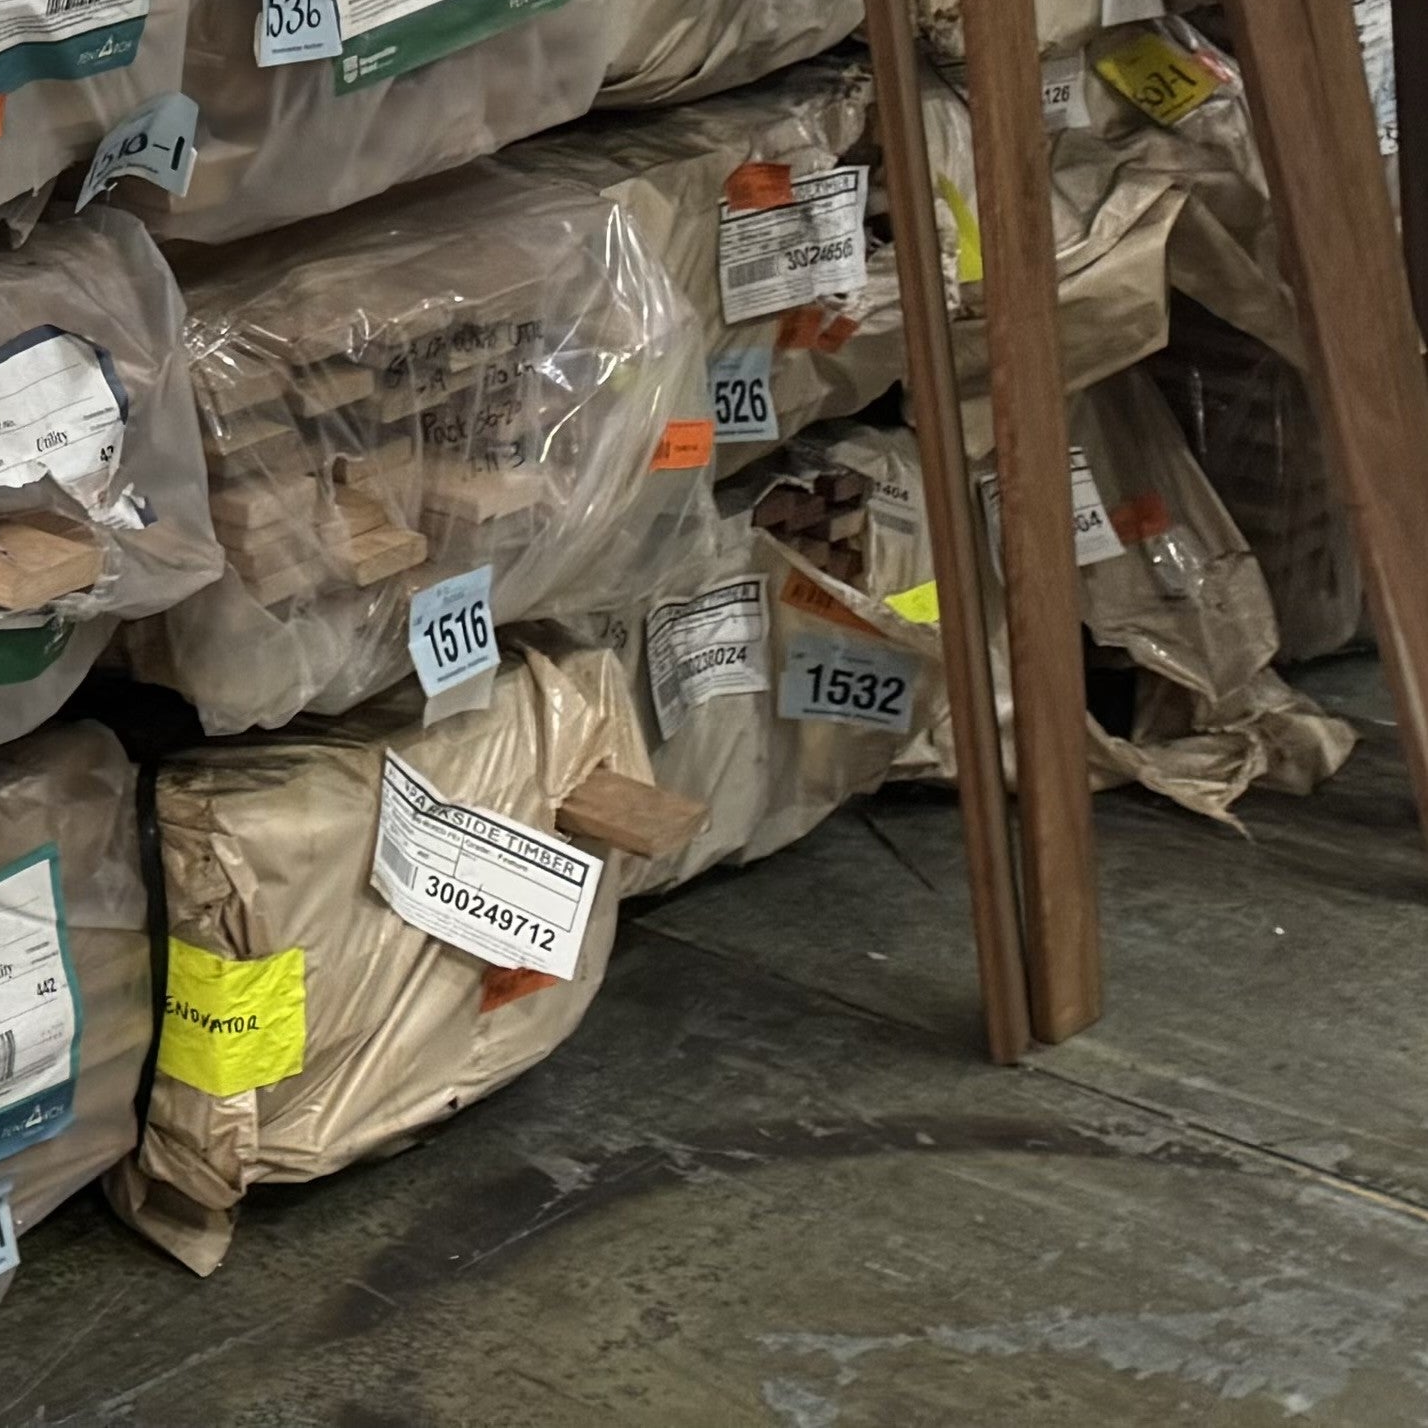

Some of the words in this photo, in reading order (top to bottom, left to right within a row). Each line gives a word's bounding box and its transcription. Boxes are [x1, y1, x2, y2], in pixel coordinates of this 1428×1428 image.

[423, 600, 488, 670] 1516
[804, 662, 907, 717] 1532
[505, 832, 574, 877] TIMBER
[425, 875, 556, 952] 300249712
